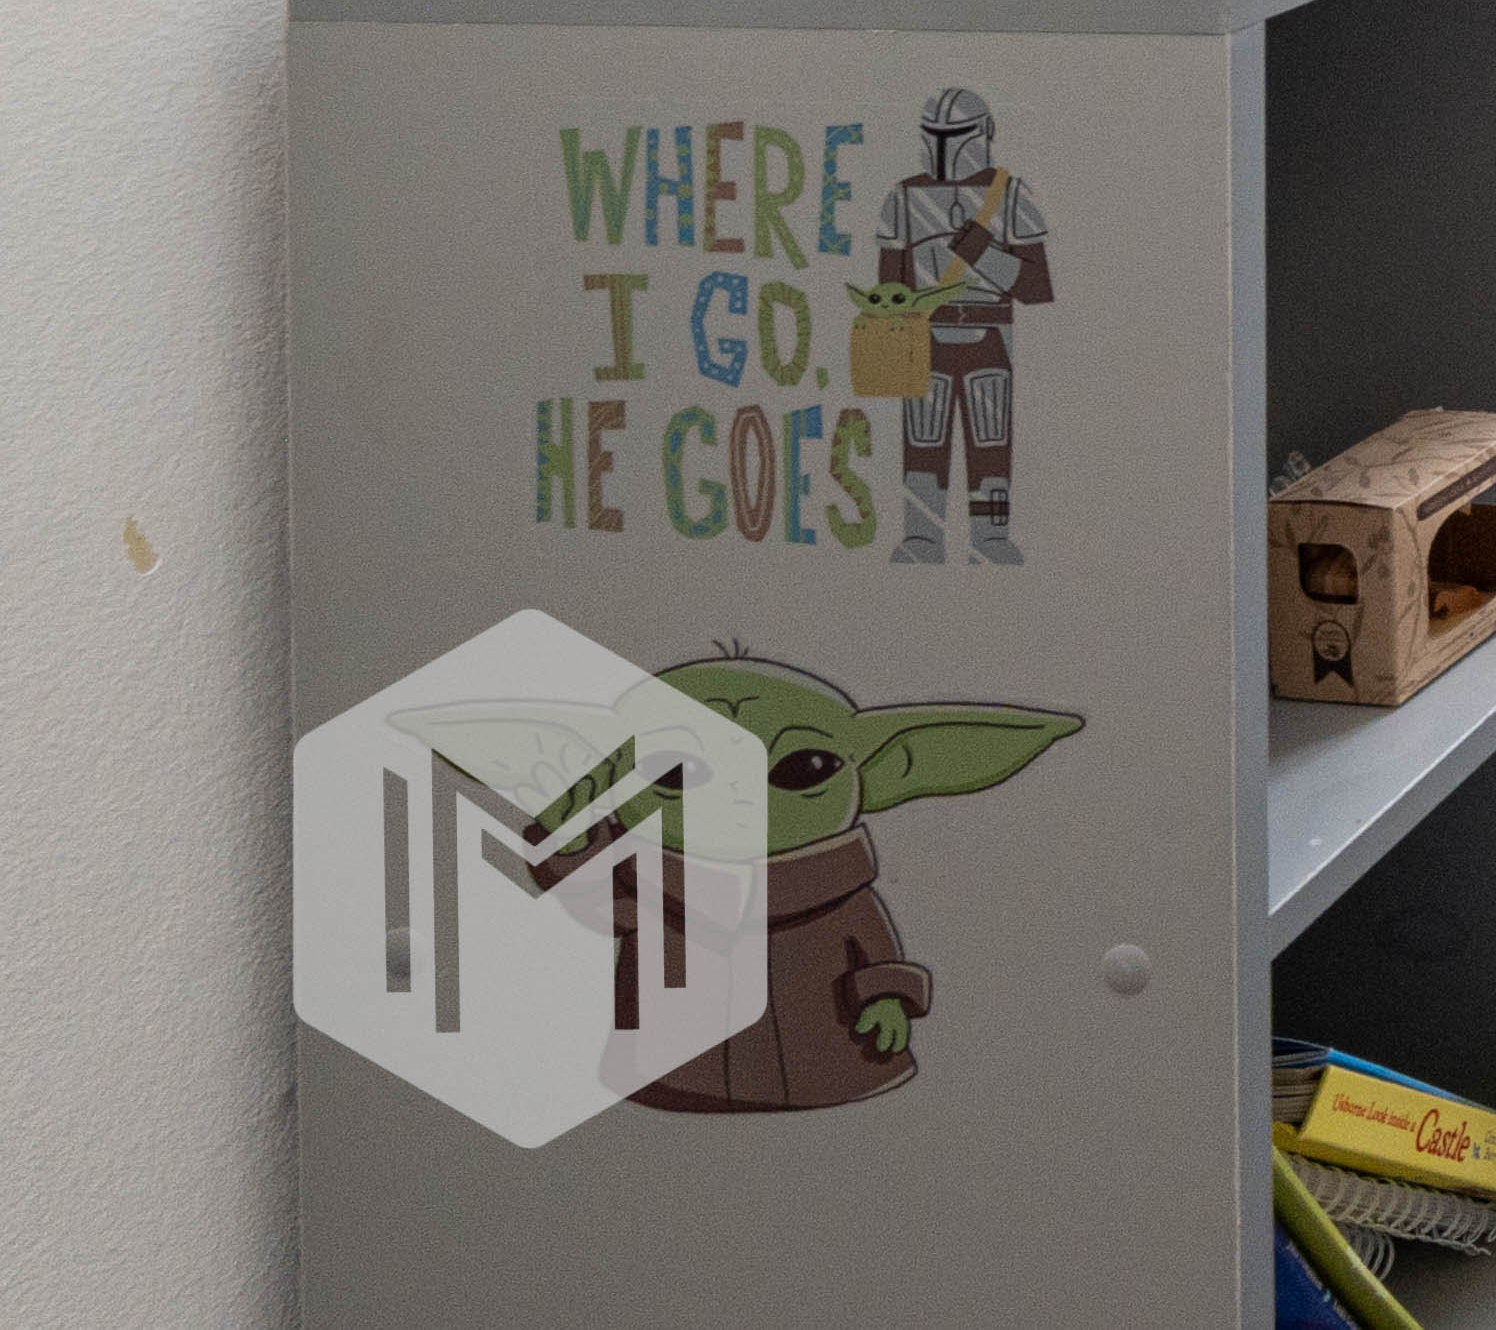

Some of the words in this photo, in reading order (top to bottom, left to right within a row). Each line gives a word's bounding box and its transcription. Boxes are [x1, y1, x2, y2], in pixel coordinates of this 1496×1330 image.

[559, 120, 865, 271] WHERE
[582, 273, 649, 382] I
[535, 396, 627, 533] HE
[661, 403, 878, 550] GOES
[1415, 1108, 1472, 1163] Castle
